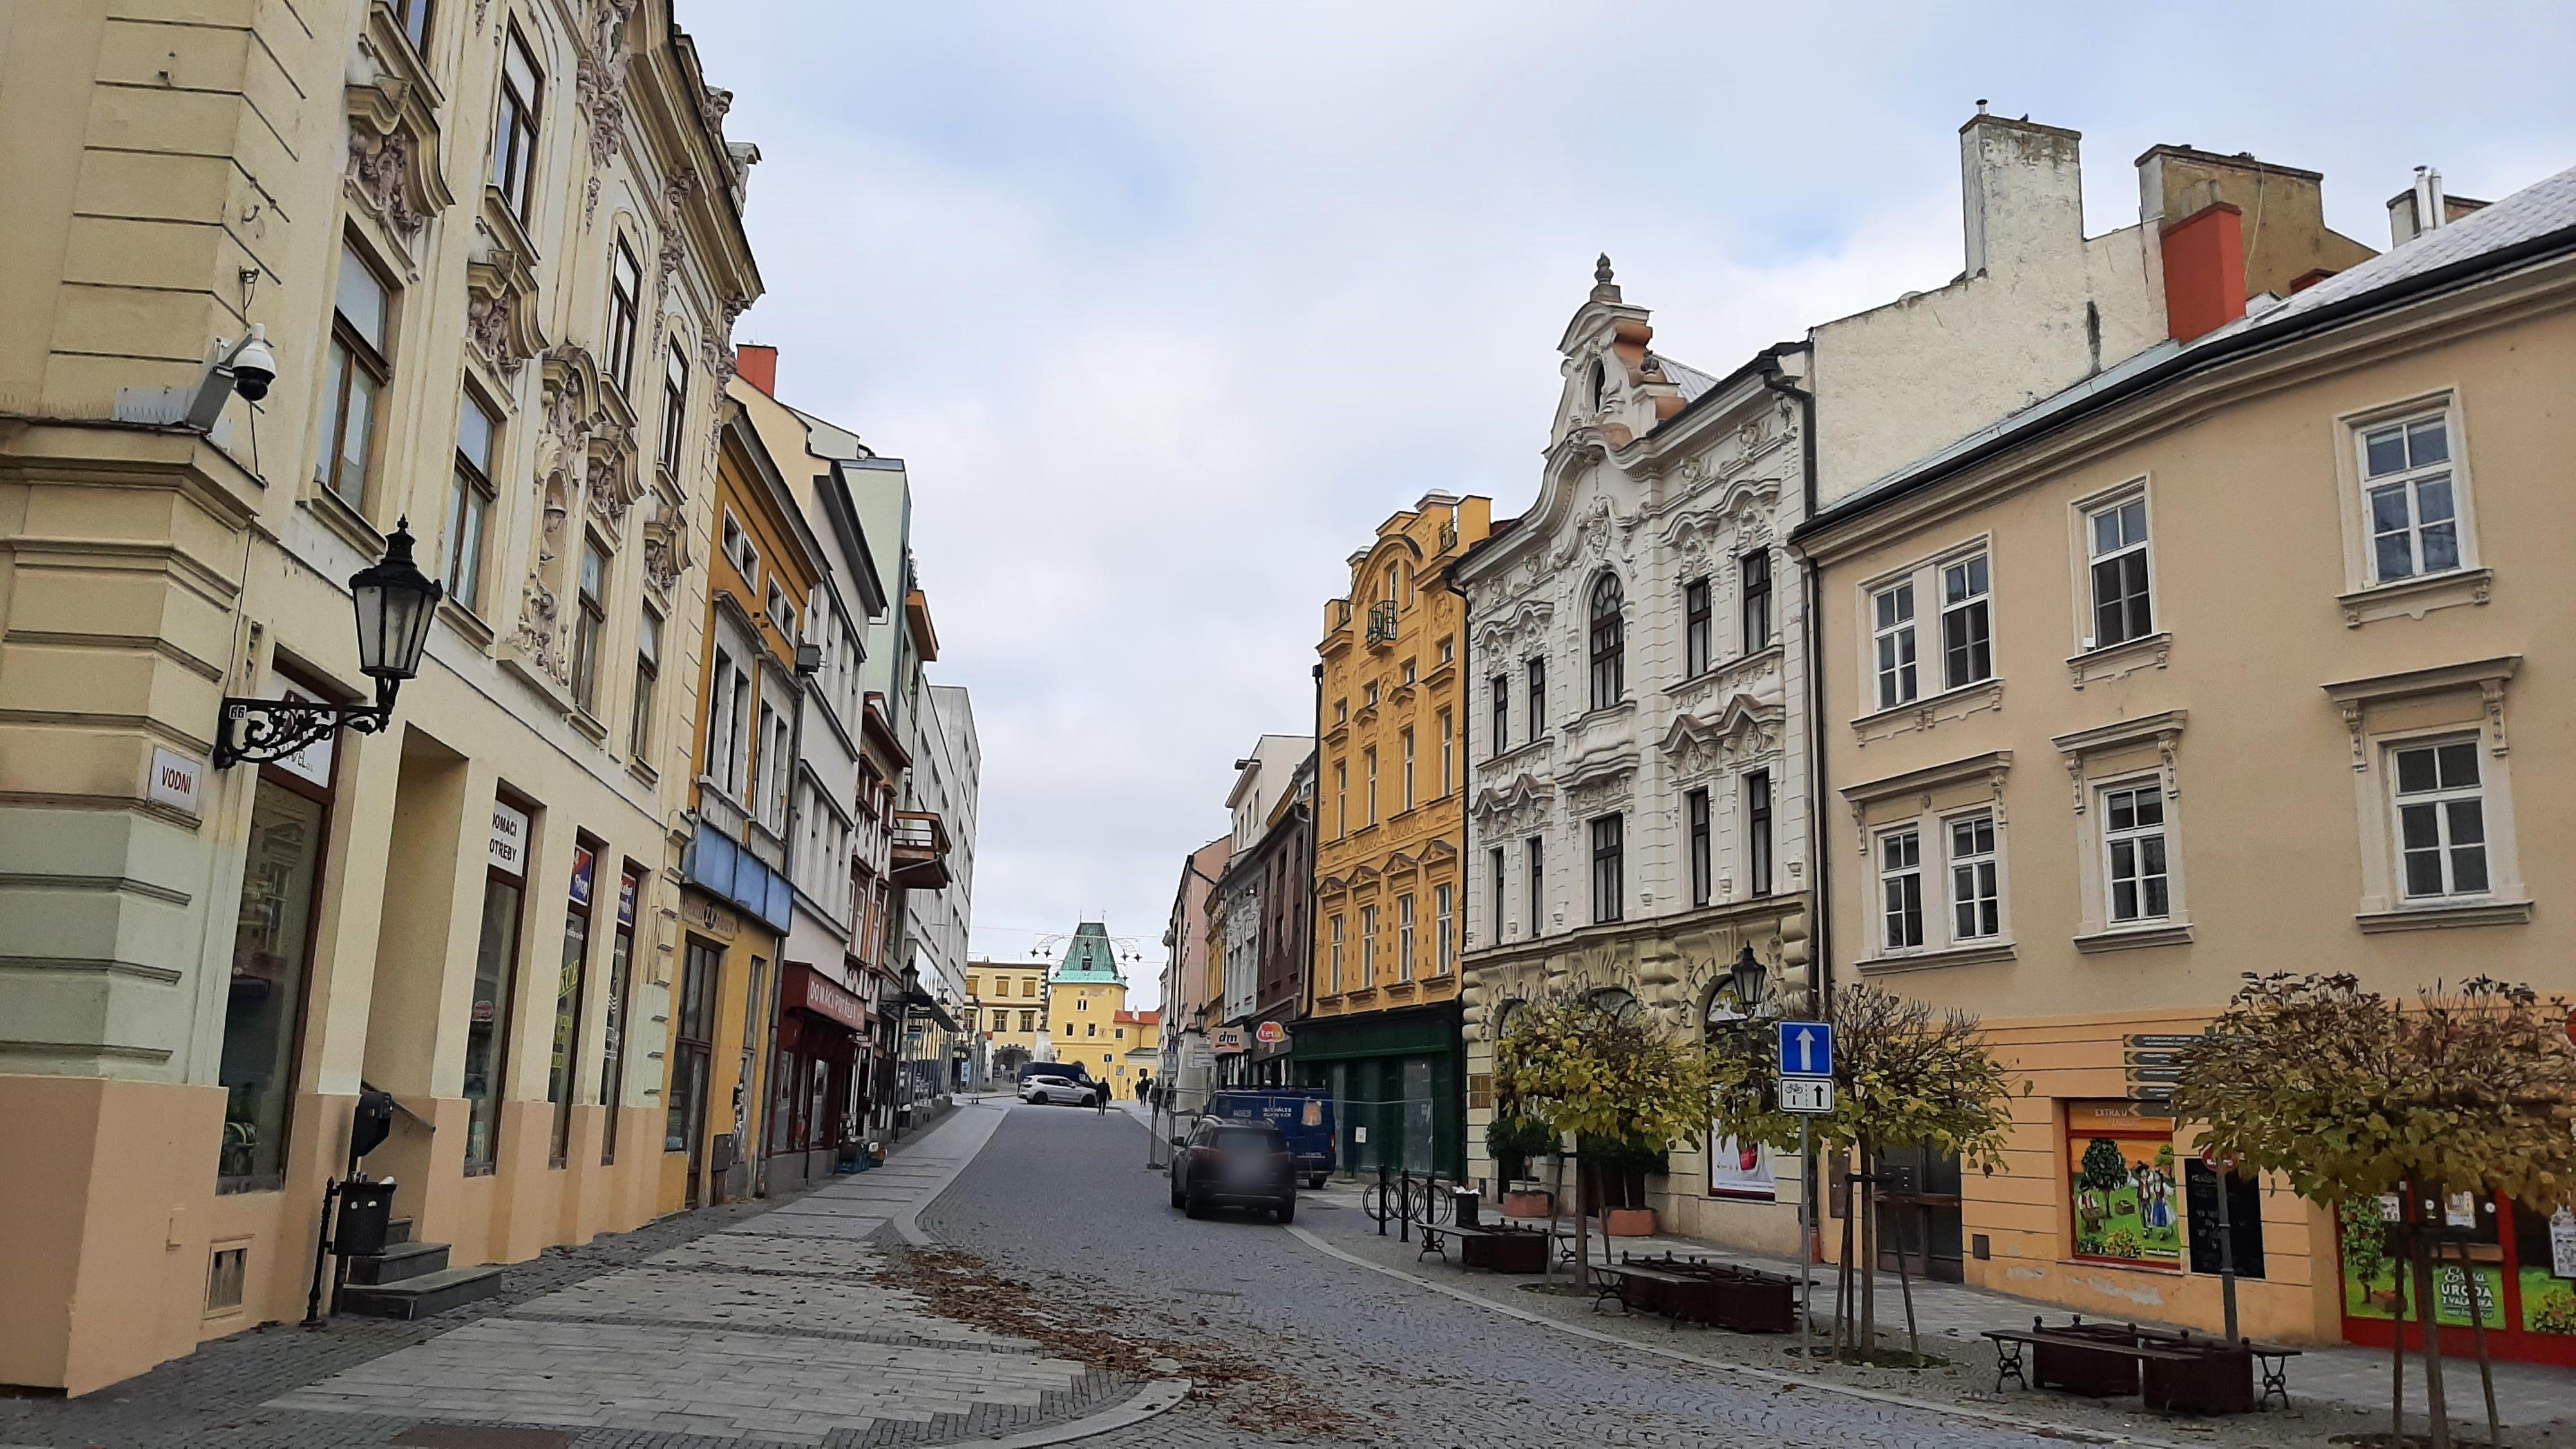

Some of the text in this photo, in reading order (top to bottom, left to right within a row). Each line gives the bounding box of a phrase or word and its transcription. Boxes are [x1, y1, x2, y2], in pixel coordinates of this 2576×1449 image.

[162, 766, 192, 795] VODNÍ
[489, 838, 517, 862] OTŘEBY
[1218, 1031, 1237, 1042] dm
[2095, 1108, 2121, 1117] EXTRA
